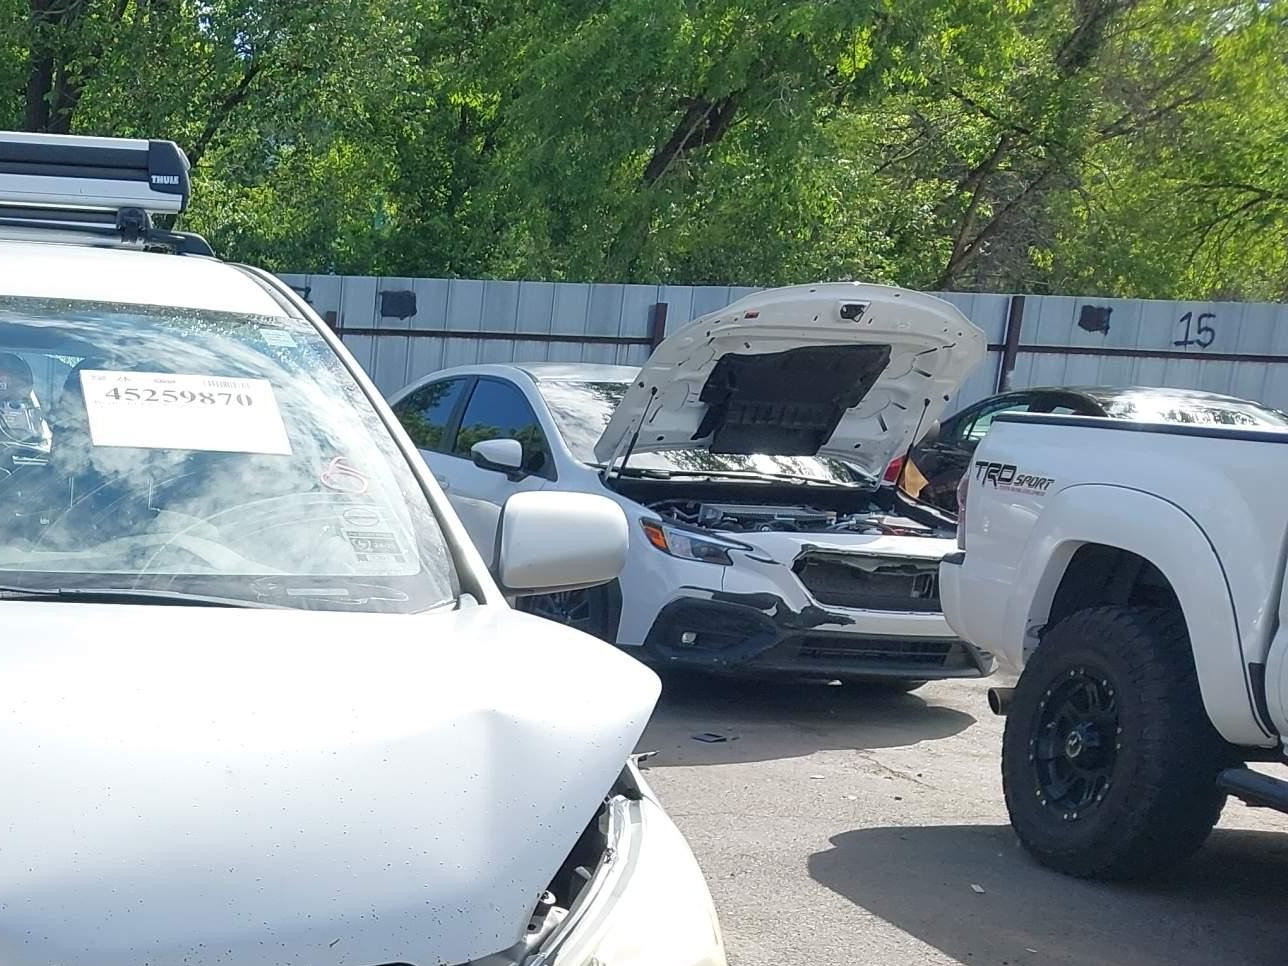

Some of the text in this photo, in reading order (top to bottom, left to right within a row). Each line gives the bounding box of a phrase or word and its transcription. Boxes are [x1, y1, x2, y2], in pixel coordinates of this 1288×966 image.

[151, 175, 179, 184] THULE
[1173, 311, 1216, 349] 15
[104, 387, 253, 407] 45259870
[975, 461, 1017, 489] TRD
[1014, 474, 1055, 491] SPORT
